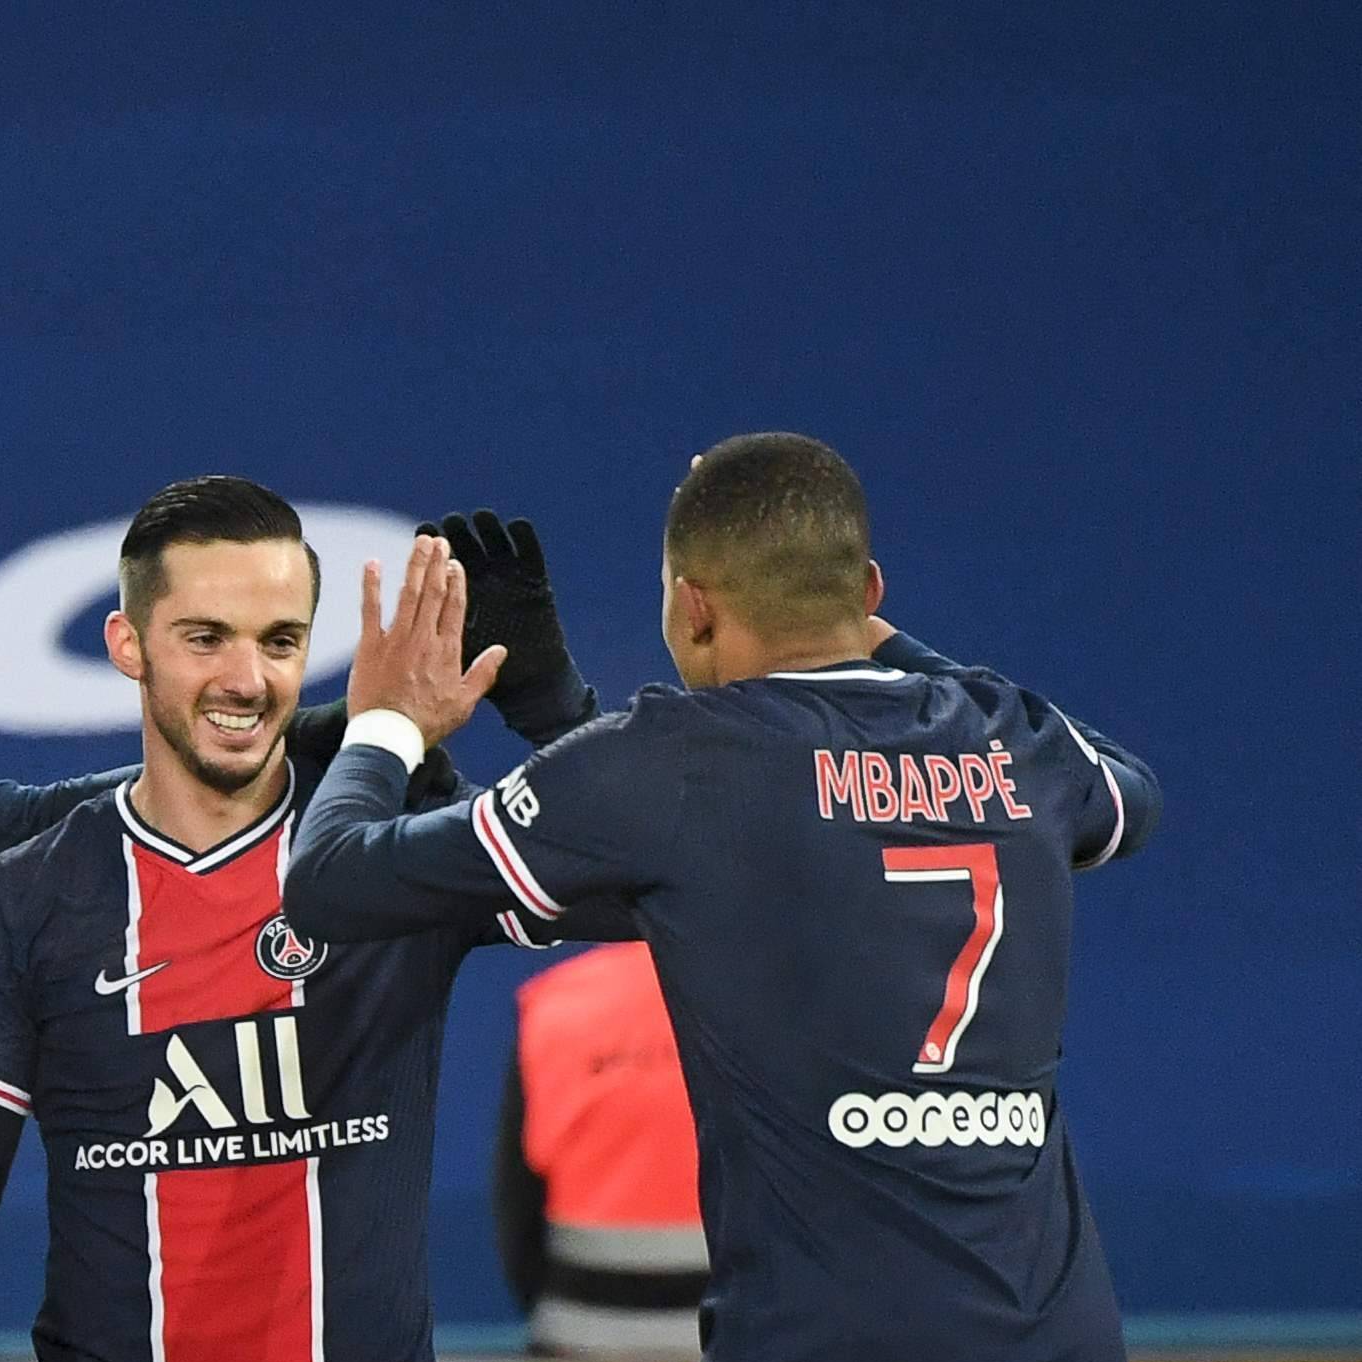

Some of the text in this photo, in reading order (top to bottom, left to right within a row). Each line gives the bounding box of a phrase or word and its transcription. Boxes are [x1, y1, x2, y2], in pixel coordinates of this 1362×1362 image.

[882, 843, 1004, 1074] 7
[74, 1114, 390, 1171] ACCOR LIVE LIMITLESS
[832, 1091, 1045, 1145] ooredoo
